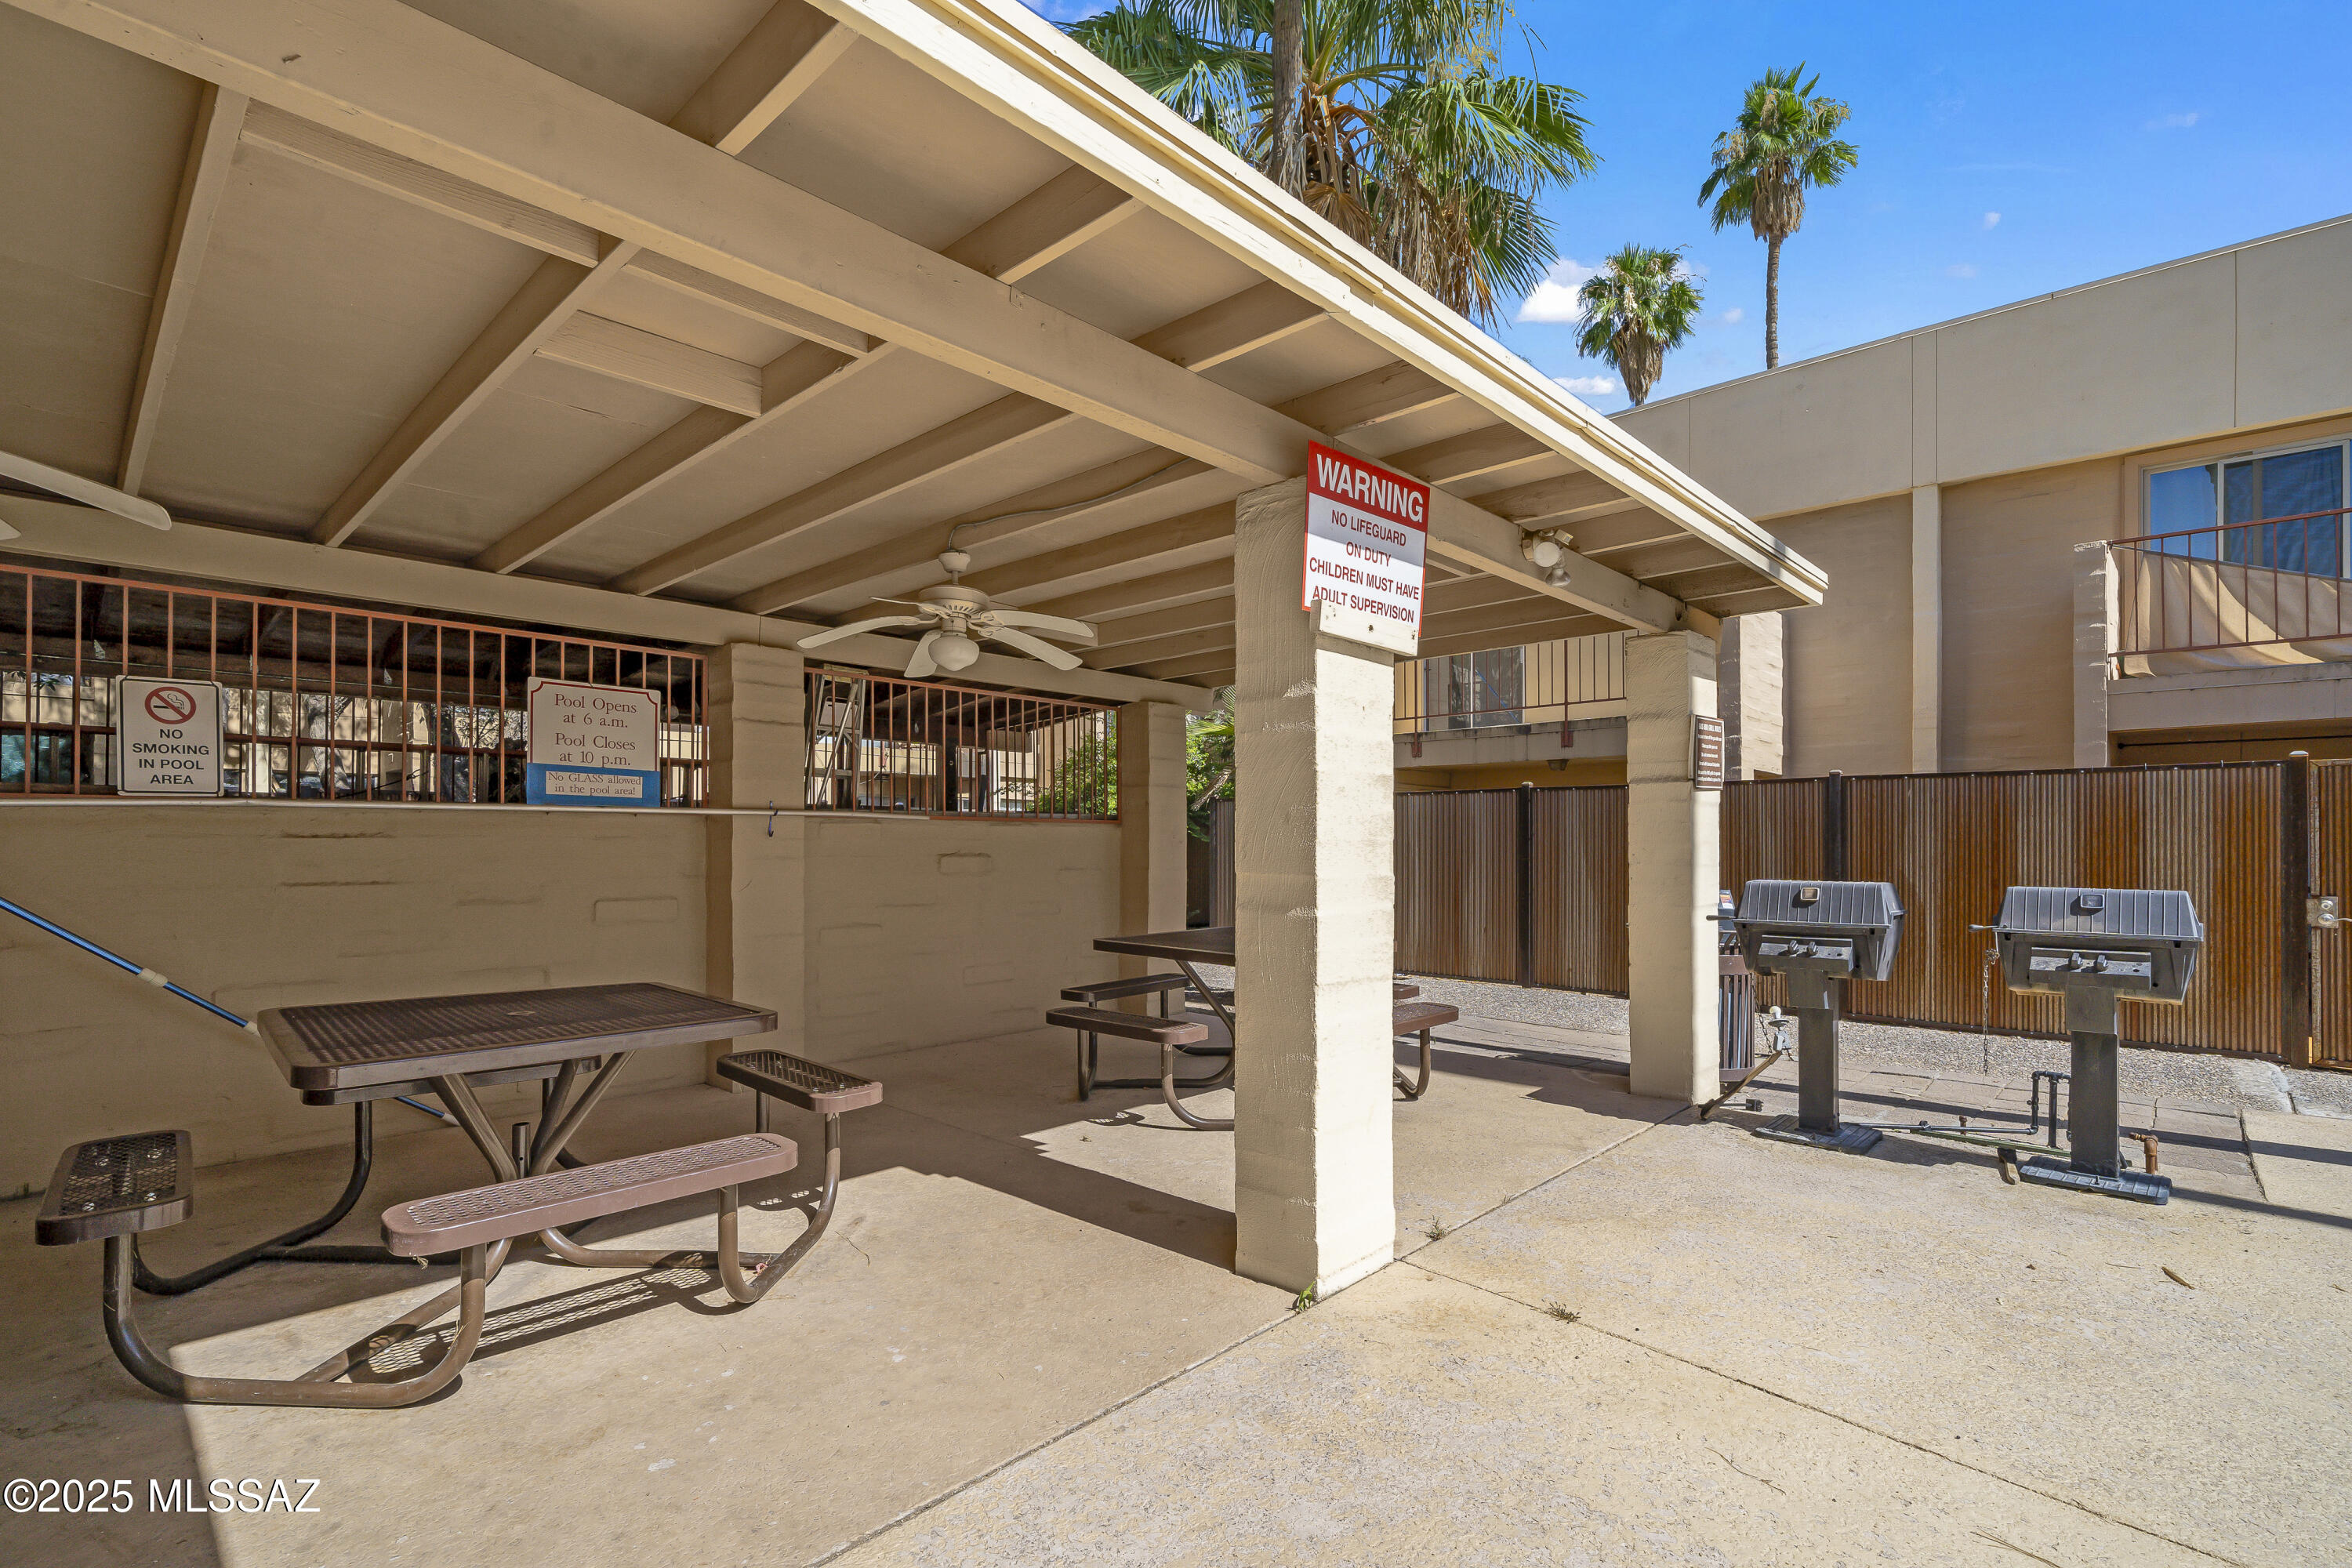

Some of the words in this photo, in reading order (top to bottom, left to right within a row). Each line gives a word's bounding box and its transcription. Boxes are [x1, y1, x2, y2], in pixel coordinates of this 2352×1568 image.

[1316, 453, 1423, 523] WARNING
[1331, 510, 1347, 528] NO
[1351, 516, 1406, 546] LIFEGUARD
[1346, 541, 1361, 558] ON
[1364, 549, 1392, 567] DUTY
[1310, 557, 1363, 585] CHILDREN
[1367, 573, 1392, 592] MUST
[1396, 583, 1419, 601] HAVE
[1312, 586, 1348, 607] ADULT
[1350, 593, 1414, 623] SUPERVISION
[555, 693, 585, 708] Pool
[593, 697, 637, 714] Opens
[563, 713, 575, 724] at
[583, 713, 593, 724] 6
[599, 717, 628, 728] a.m.
[159, 728, 183, 739] NO
[555, 732, 585, 747] Pool
[593, 735, 636, 750] Closes
[132, 742, 209, 755] SMOKING
[139, 759, 154, 768] IN
[161, 760, 204, 770] POOL
[559, 752, 572, 762] at
[580, 751, 593, 764] 10
[601, 755, 630, 768] p.m.
[150, 775, 194, 784] AREA
[548, 771, 564, 782] No
[568, 773, 603, 783] GLASS
[608, 776, 641, 785] allowed
[570, 784, 585, 793] the
[590, 786, 610, 796] pool
[615, 786, 636, 795] area!
